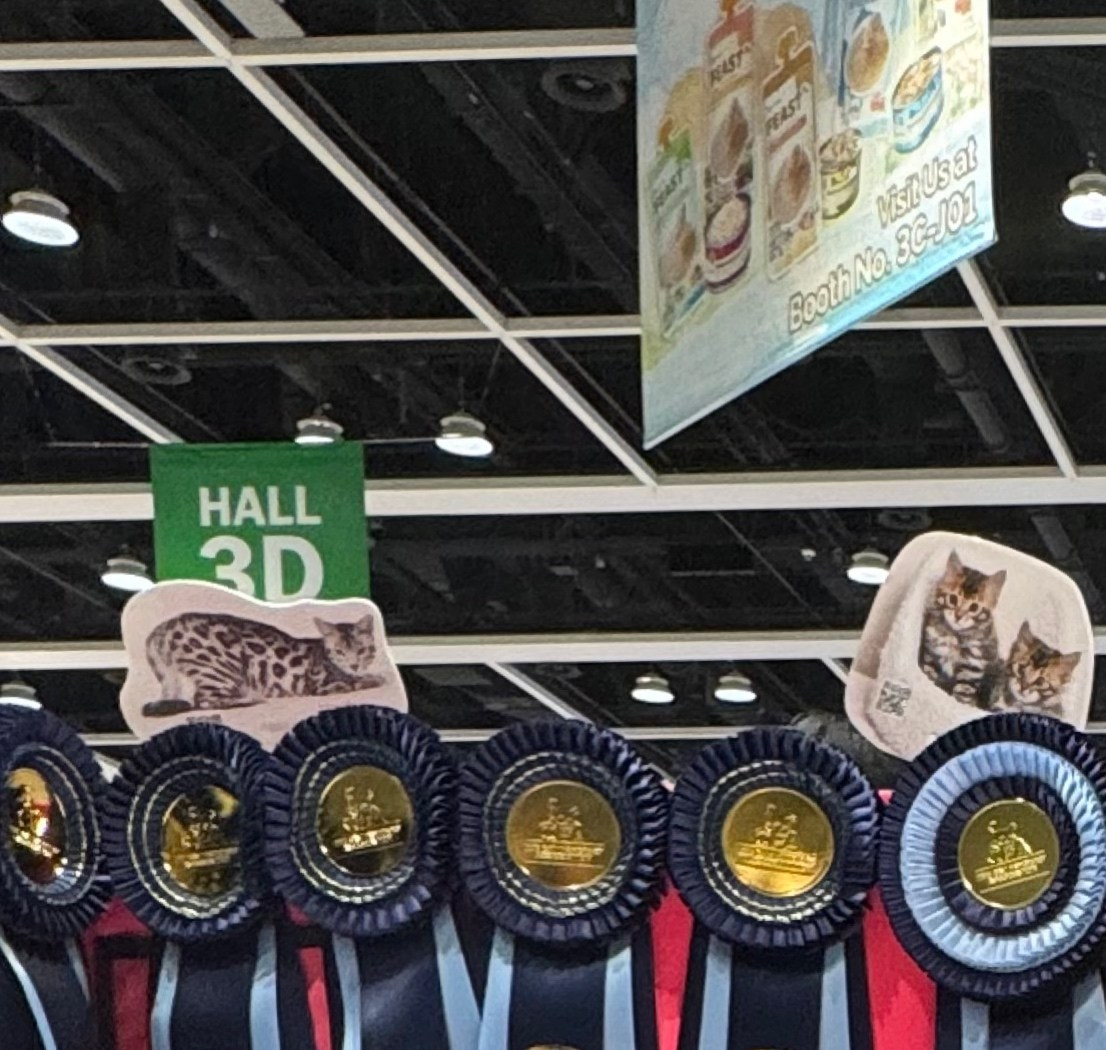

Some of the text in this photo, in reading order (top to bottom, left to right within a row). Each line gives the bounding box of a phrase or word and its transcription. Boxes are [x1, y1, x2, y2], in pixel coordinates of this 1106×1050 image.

[710, 52, 744, 87] FEAST
[766, 90, 804, 135] FEAST
[876, 138, 979, 229] Visit Us at
[788, 181, 979, 335] Booth No. 3C-J01
[199, 485, 322, 527] HALL
[200, 534, 324, 603] 3D
